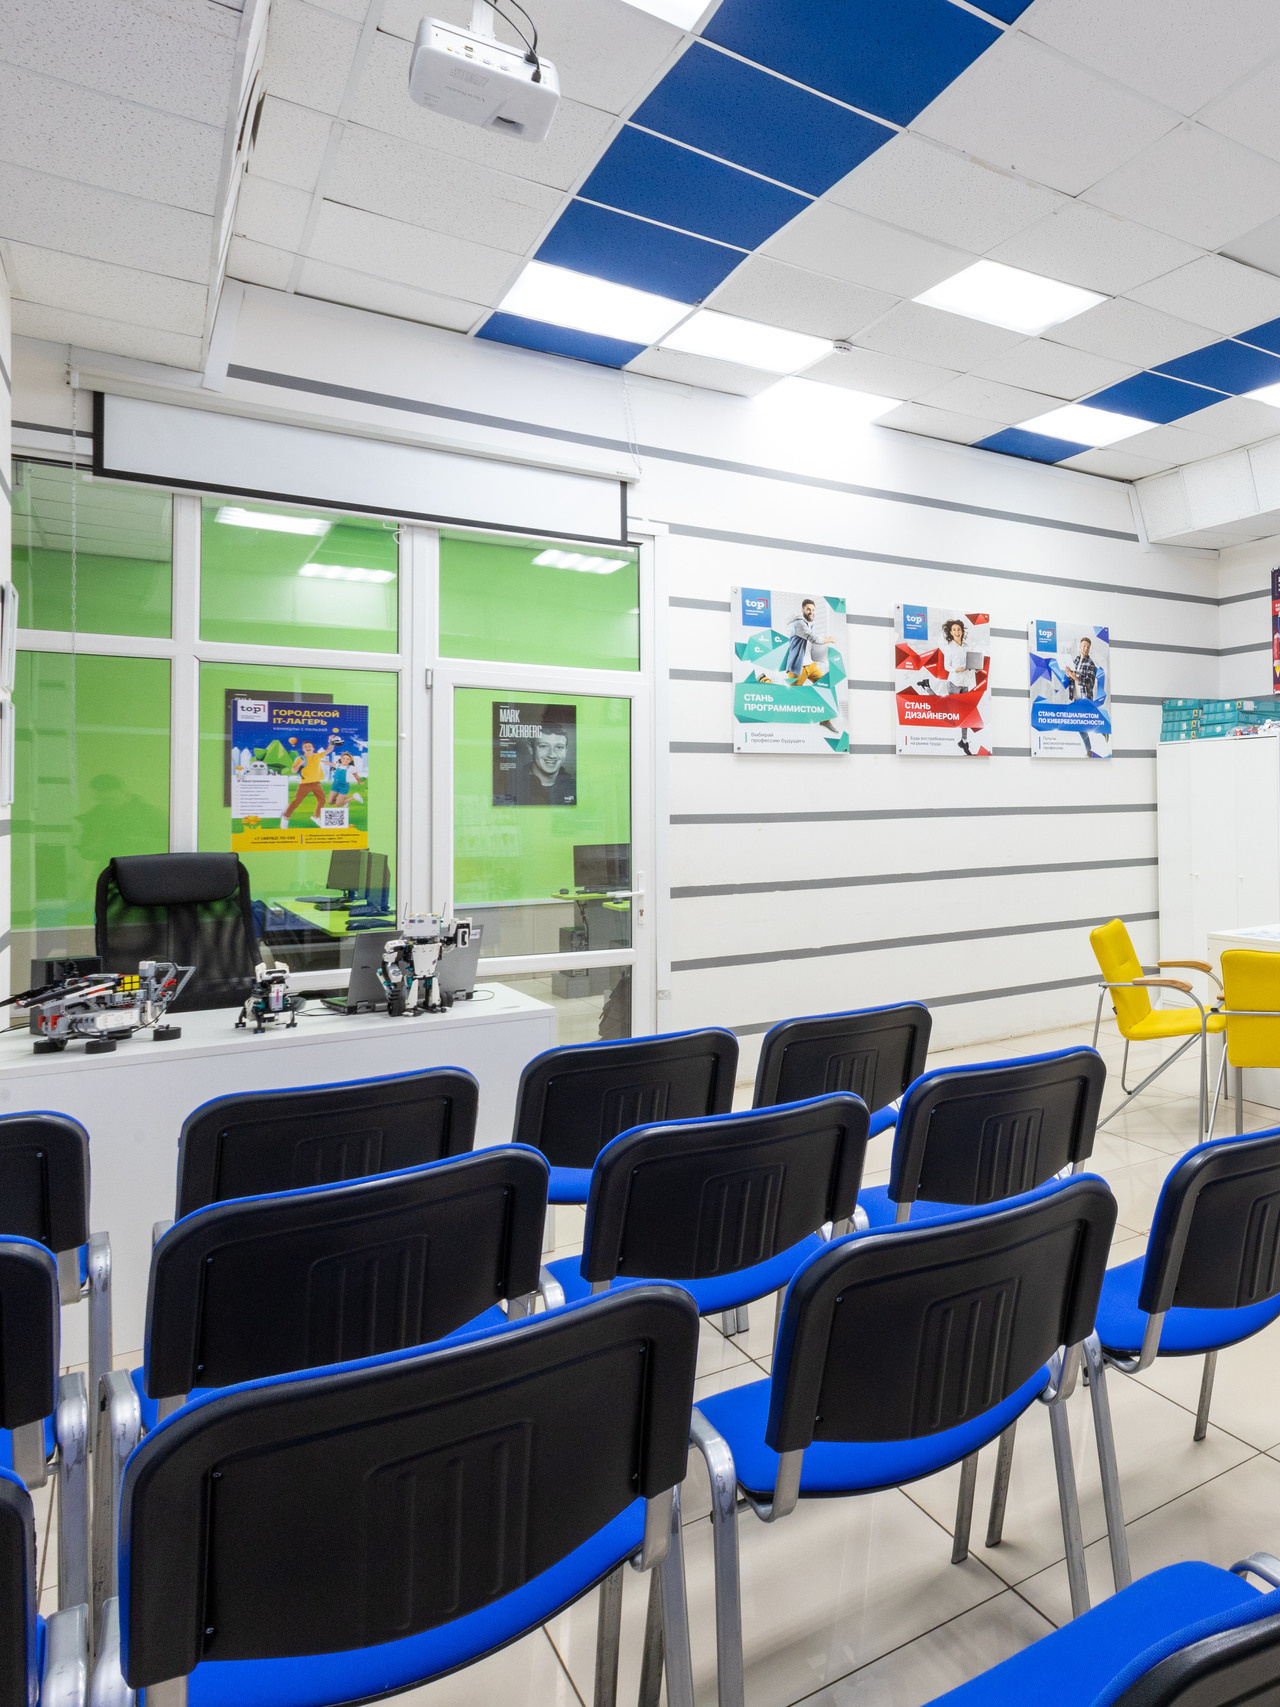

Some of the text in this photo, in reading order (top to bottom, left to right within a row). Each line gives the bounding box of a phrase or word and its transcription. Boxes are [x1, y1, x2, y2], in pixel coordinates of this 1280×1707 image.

[745, 599, 765, 610] top
[906, 614, 922, 624] top
[1038, 629, 1052, 638] top
[744, 693, 774, 702] СТАНЬ
[240, 705, 262, 714] top
[744, 703, 825, 714] ПРОГРАММИСТОМ
[904, 701, 931, 710] СТАНЬ
[273, 708, 340, 718] ГОРОДСКОЙ
[500, 709, 520, 722] MARK
[904, 711, 960, 720] ДИЗАЙНЕРОМ
[1056, 711, 1099, 719] СПЕЦИАЛИСТОМ
[273, 717, 328, 726] IT-ЛАГЕРЬ
[1047, 718, 1105, 726] КИБЕРБЕЗОПАСНОСТИ
[499, 724, 542, 738] ZUCKERBERG
